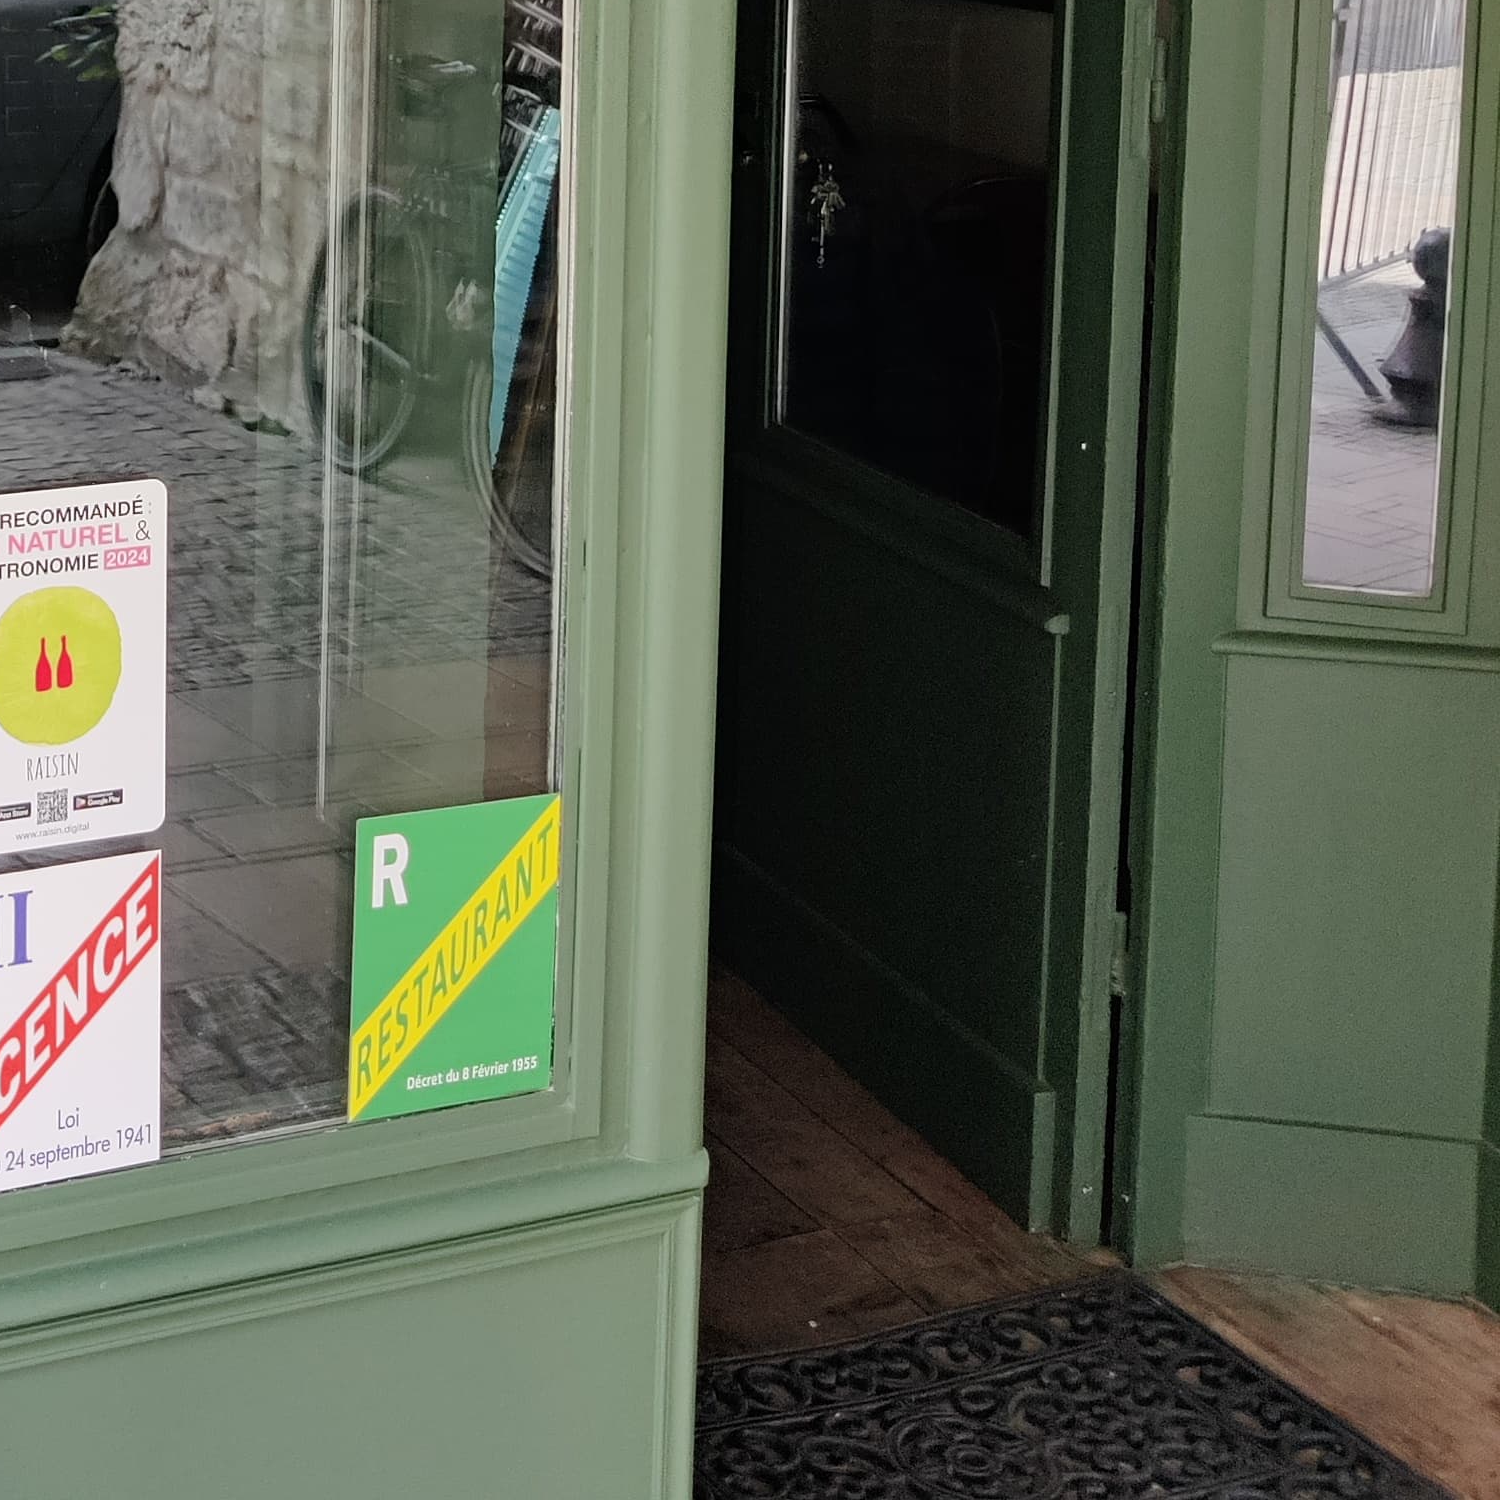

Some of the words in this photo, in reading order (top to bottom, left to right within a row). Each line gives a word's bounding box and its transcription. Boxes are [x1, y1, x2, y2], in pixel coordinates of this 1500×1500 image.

[0, 494, 144, 530] RECOMMANDÉ
[8, 523, 129, 556] NATUREL
[135, 519, 151, 541] &
[105, 548, 150, 567] 2024
[26, 751, 80, 782] RAISIN
[15, 821, 91, 842] www.raisin.digital
[371, 832, 409, 910] R
[356, 818, 554, 1100] RESTAURANT
[406, 1071, 444, 1091] Décret
[446, 1068, 460, 1084] du
[462, 1067, 470, 1081] 8
[472, 1060, 509, 1079] Février
[511, 1055, 538, 1074] 1955
[57, 1108, 80, 1130] Loi
[5, 1150, 26, 1172] 24
[29, 1134, 111, 1171] septembre
[116, 1123, 152, 1151] 1941
